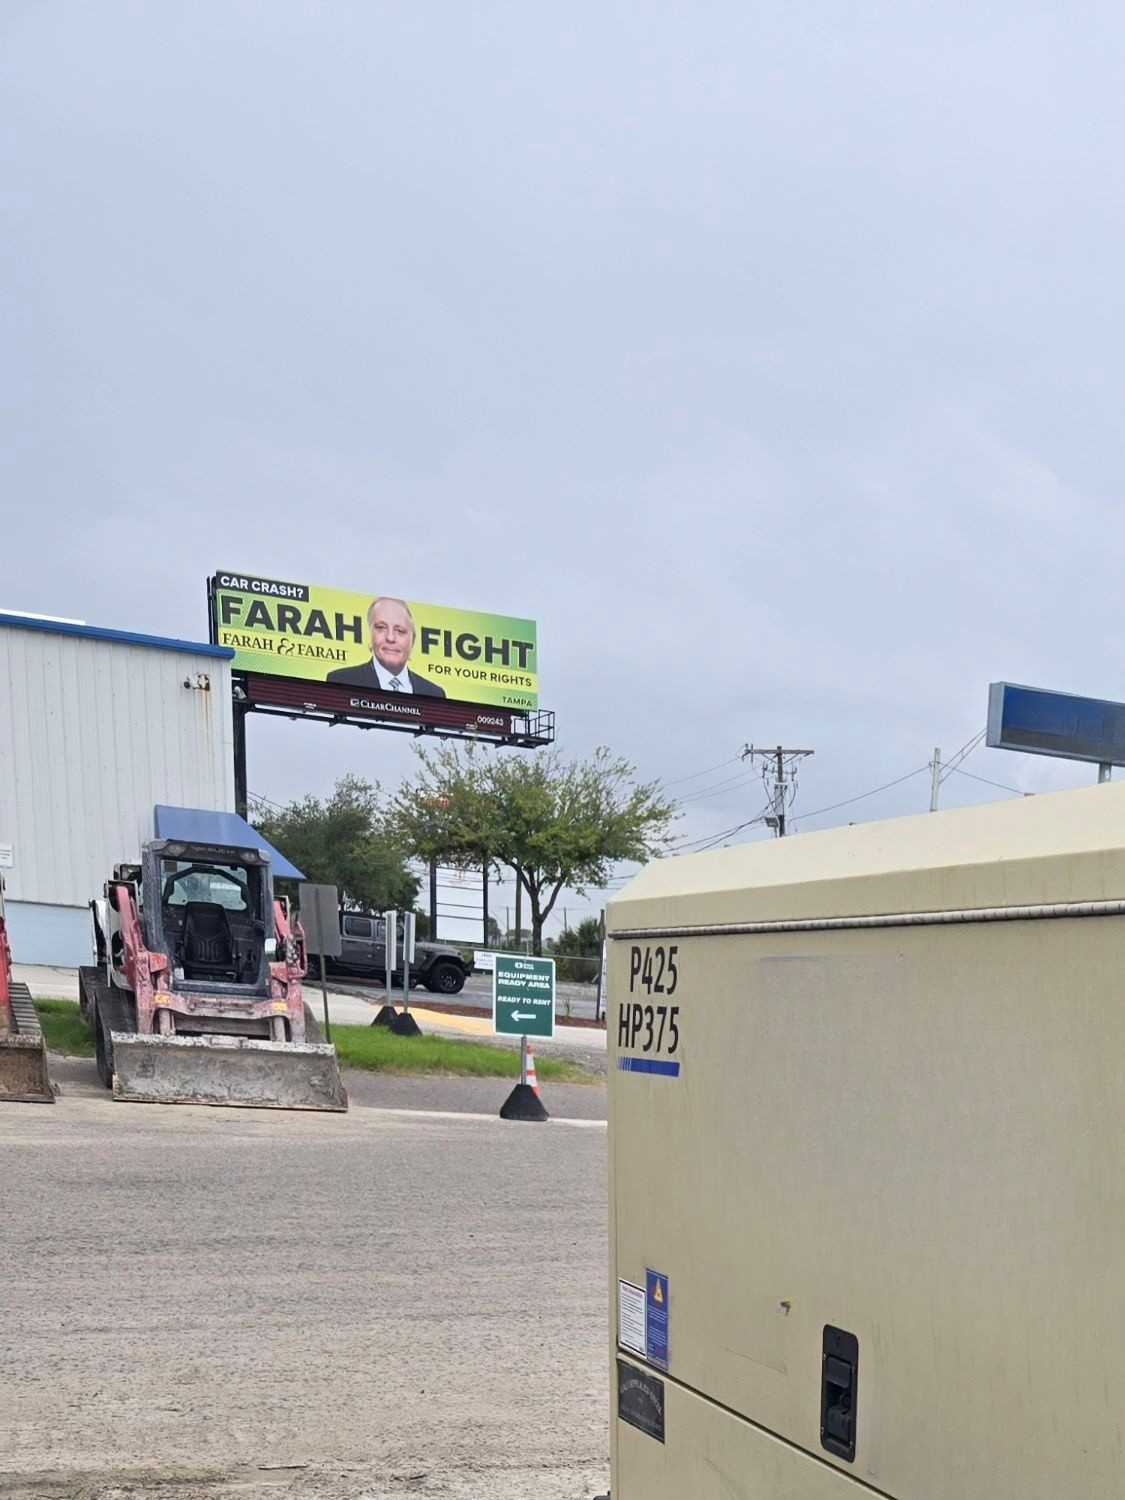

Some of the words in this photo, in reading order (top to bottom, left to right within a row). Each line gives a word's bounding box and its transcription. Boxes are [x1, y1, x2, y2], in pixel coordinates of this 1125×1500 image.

[220, 576, 249, 590] CAR
[251, 581, 304, 599] CRASH?
[221, 595, 362, 644] FARAH
[223, 633, 273, 651] FARAH
[277, 638, 295, 656] &
[297, 643, 347, 662] FARAH
[421, 626, 534, 669] FIGHT
[428, 664, 451, 676] FOR
[454, 667, 487, 680] YOUR
[490, 672, 532, 687] RIGHTS
[502, 696, 533, 707] TAMPA
[498, 971, 550, 982] EQUIPMENT
[630, 946, 679, 995] P425
[498, 978, 527, 987] READY
[528, 980, 550, 989] AREA
[497, 995, 521, 1004] READY
[533, 998, 551, 1006] RENT
[618, 1003, 680, 1054] HP375
